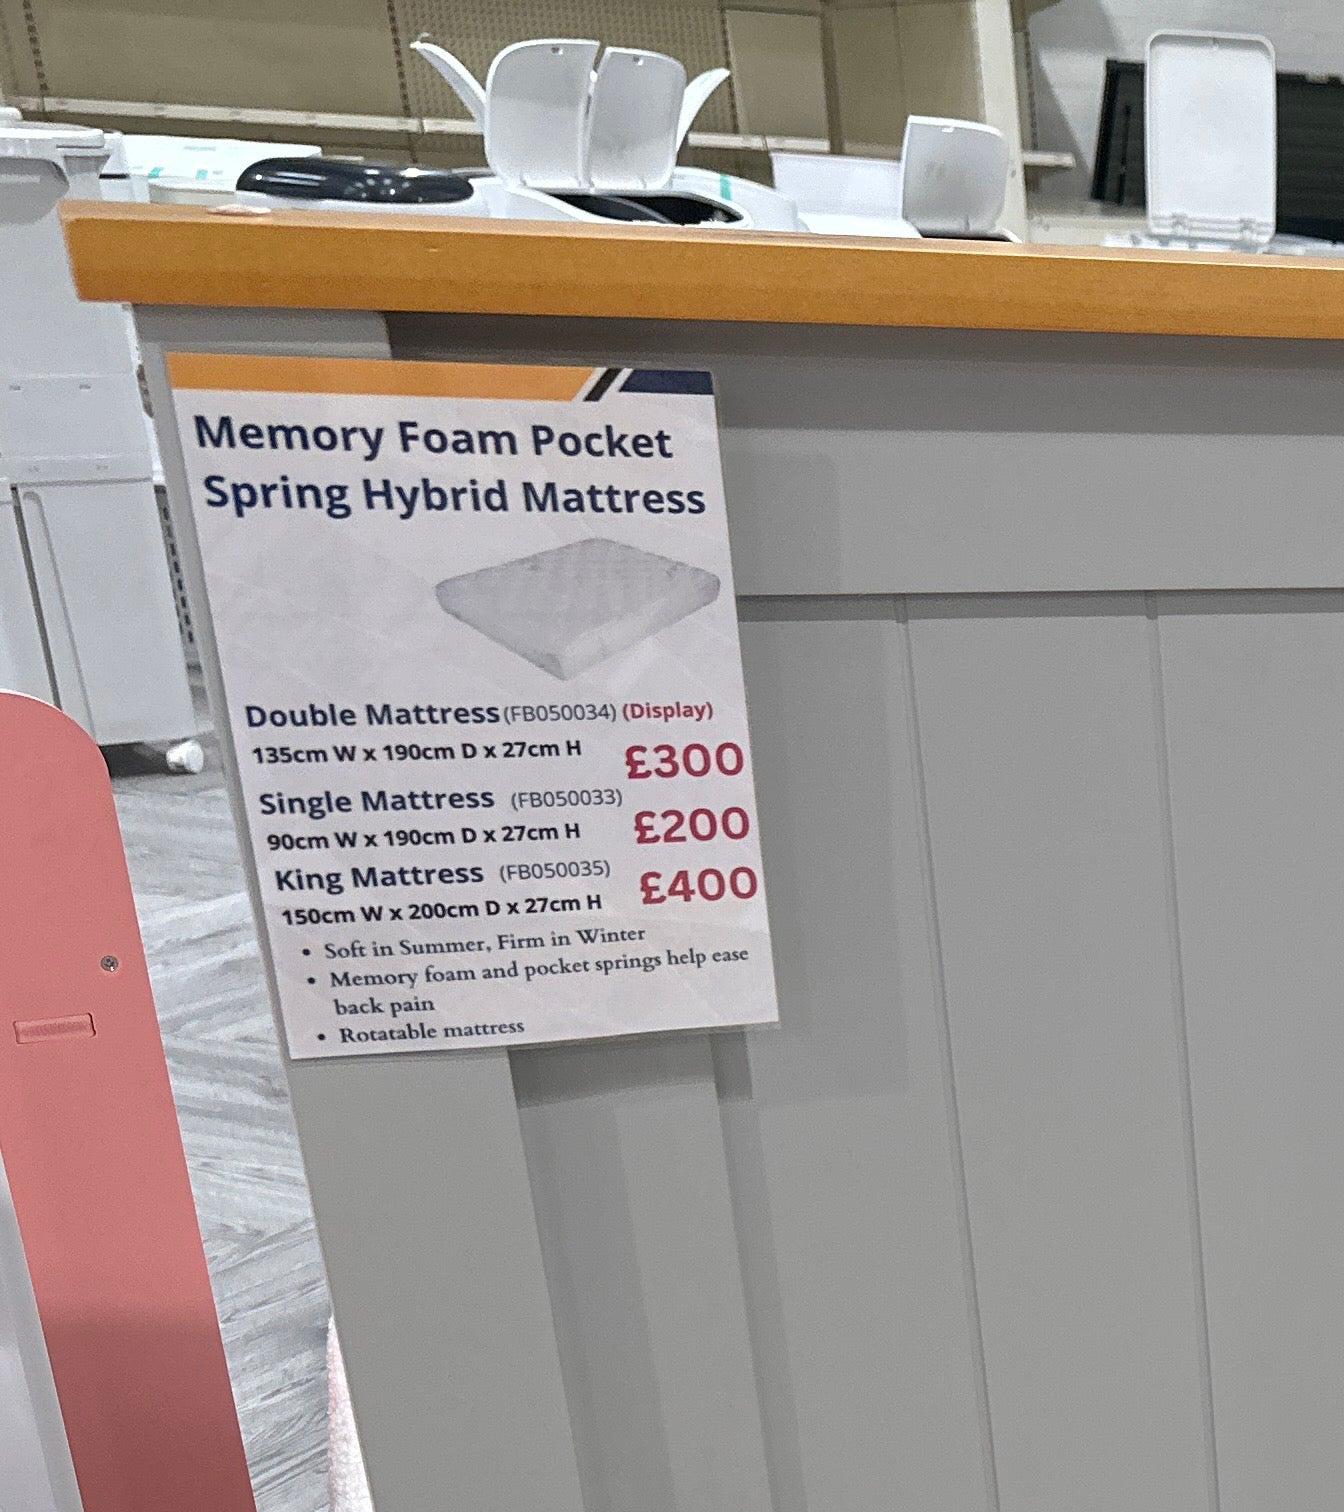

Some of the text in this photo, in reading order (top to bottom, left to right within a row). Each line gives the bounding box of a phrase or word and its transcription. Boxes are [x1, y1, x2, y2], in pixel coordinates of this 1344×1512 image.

[194, 415, 674, 461] Memory Foam Pocket
[204, 475, 706, 520] Spring Hybrid Mattress
[245, 701, 714, 728] Double Mattress (FB050034) (Display)
[253, 740, 582, 764] 135cm W x 190cm D x 27cm H
[624, 742, 744, 779] £300
[259, 788, 623, 820] Single Mattress (FB050033)
[267, 823, 581, 851] 90cm W x 190cm D x 27cm H
[634, 807, 749, 844] £200
[275, 860, 611, 895] King Mattress (FB050035)
[639, 866, 758, 905] £400
[282, 894, 603, 925] 150cm W x 200cm D x 27cm H
[324, 927, 647, 960] Soft in Summer, Firm in Winter
[329, 947, 750, 988] Memory foam and pocket springs help ease
[333, 996, 436, 1018] back pain
[338, 1019, 526, 1043] Rotatable mattress
